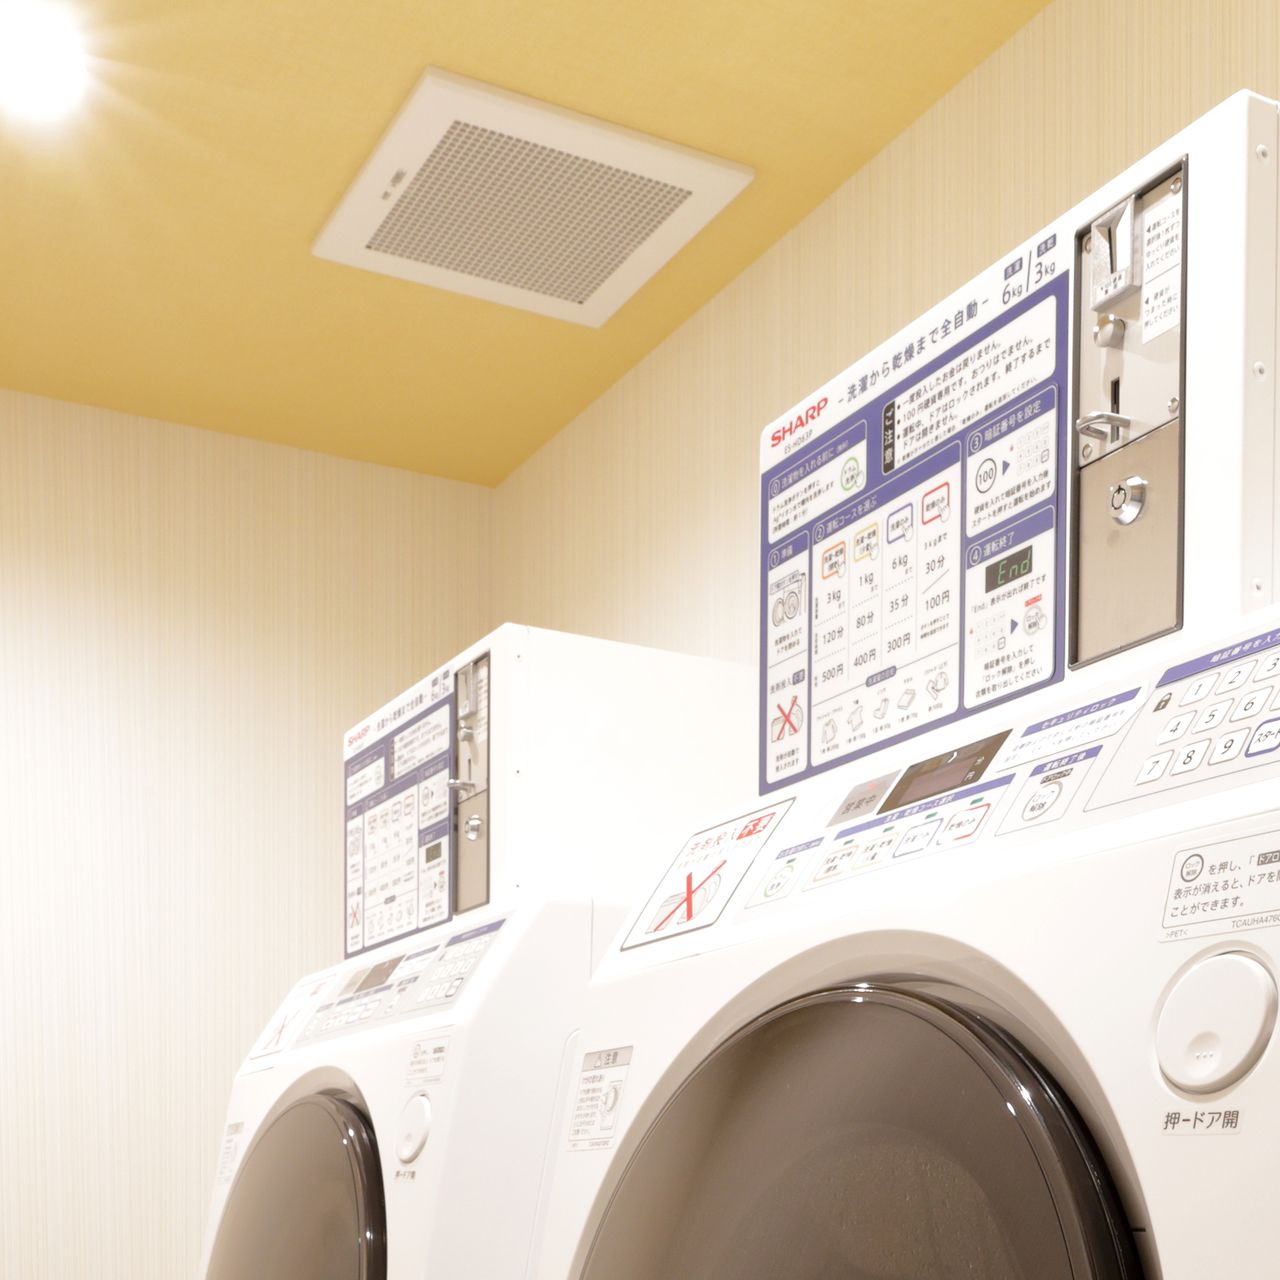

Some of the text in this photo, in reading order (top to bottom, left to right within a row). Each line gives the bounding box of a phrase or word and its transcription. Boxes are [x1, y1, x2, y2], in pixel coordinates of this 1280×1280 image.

[1035, 252, 1056, 286] 3kg
[1003, 274, 1023, 307] 6kg
[771, 395, 828, 450] SHARP
[985, 399, 1041, 443] 暗証番号を設定
[979, 467, 994, 486] 100
[826, 495, 878, 535] 運転コースを選ぶ
[983, 531, 1015, 558] 運転終了
[892, 552, 908, 574] 6kg
[926, 554, 945, 576] 30分
[998, 547, 1031, 586] End
[859, 570, 874, 590] 1kg
[827, 587, 841, 608] 3kg
[890, 593, 909, 614] 35分
[926, 589, 950, 613] 100円
[856, 610, 874, 630] 80分
[823, 625, 844, 647] 120分
[888, 631, 911, 654] 300円
[854, 647, 876, 670] 400円
[822, 663, 844, 684] 500円
[1194, 684, 1204, 696] 1
[1228, 671, 1243, 685] 2
[1266, 658, 1280, 672] 3
[1170, 721, 1180, 734] 4
[1206, 710, 1217, 723] 5
[1244, 697, 1255, 711] 6
[348, 724, 370, 747] SHARP
[1151, 761, 1161, 774] 7
[1183, 750, 1195, 764] 8
[1221, 740, 1234, 754] 9
[1170, 896, 1245, 918] ことができます。
